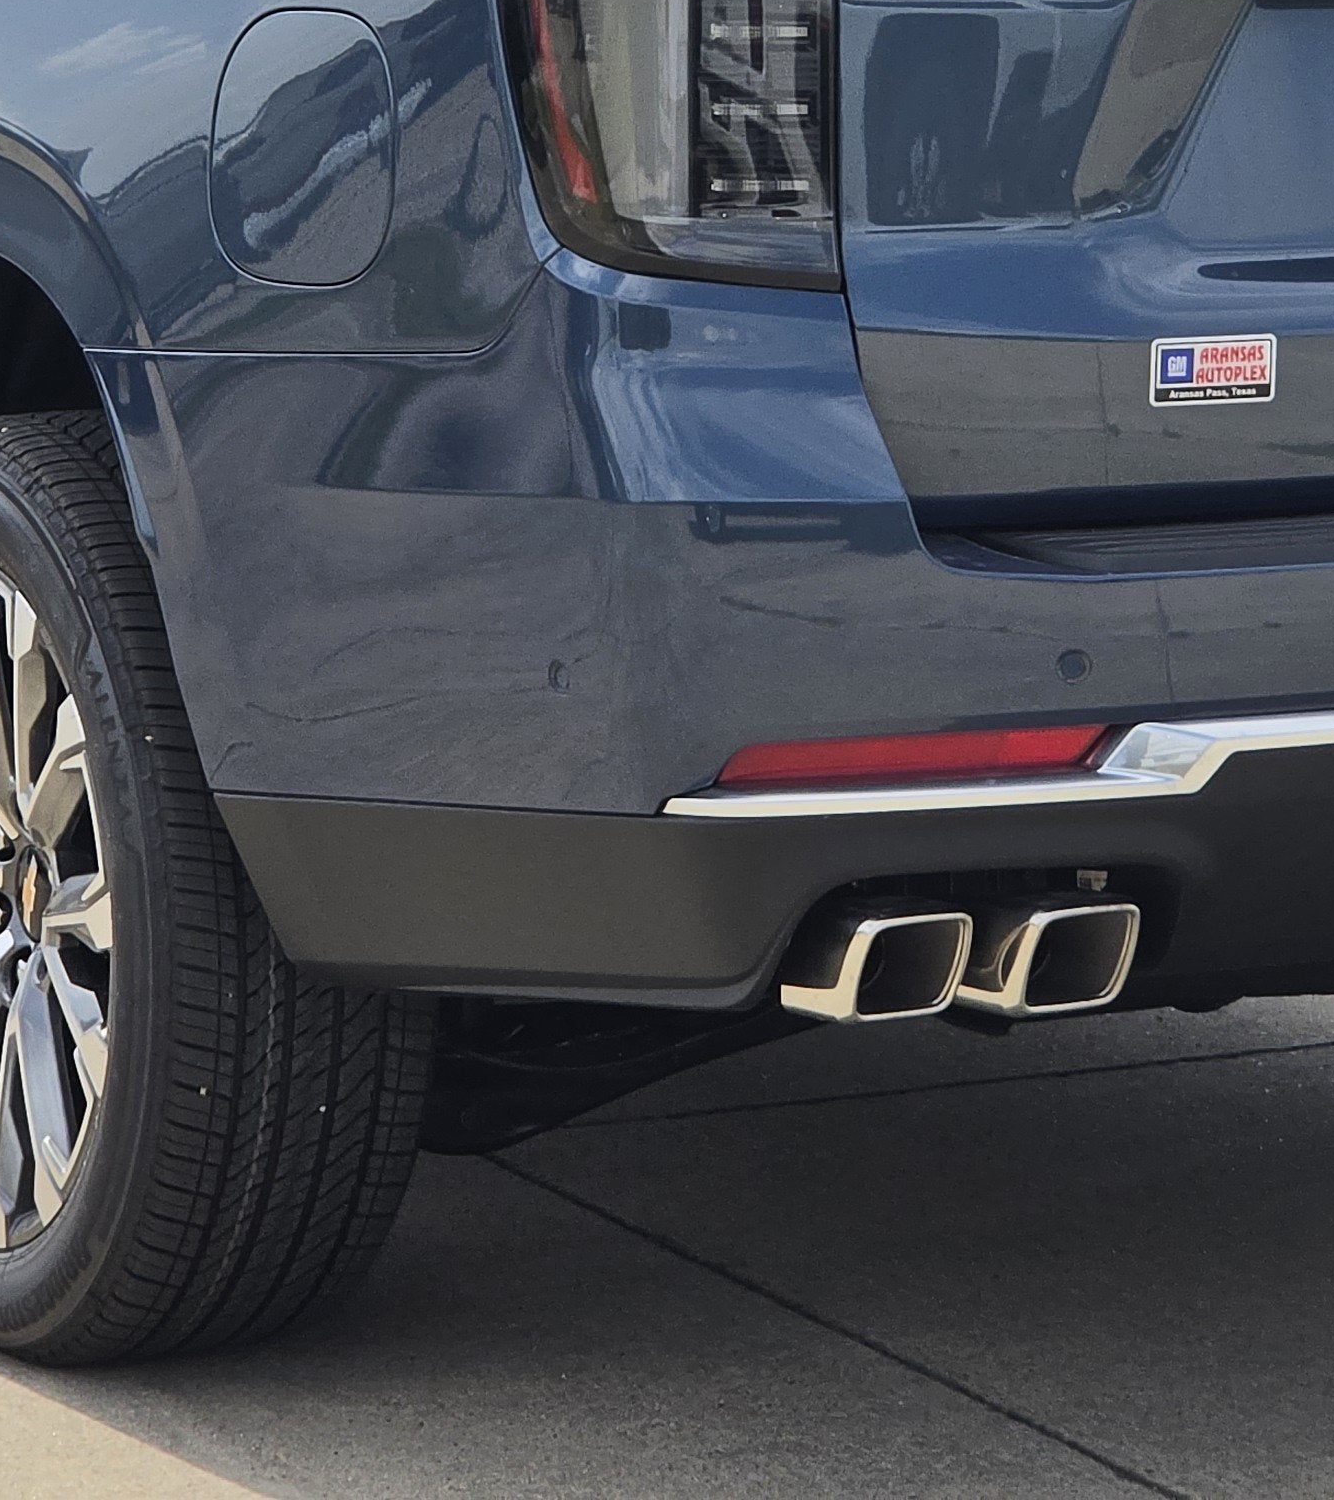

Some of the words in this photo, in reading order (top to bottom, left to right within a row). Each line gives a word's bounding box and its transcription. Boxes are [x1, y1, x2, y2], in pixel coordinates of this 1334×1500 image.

[1199, 345, 1265, 365] ARANSAS
[1195, 365, 1267, 385] AUTOPLEX
[1169, 389, 1205, 399] Aransas
[1231, 386, 1257, 397] Texas
